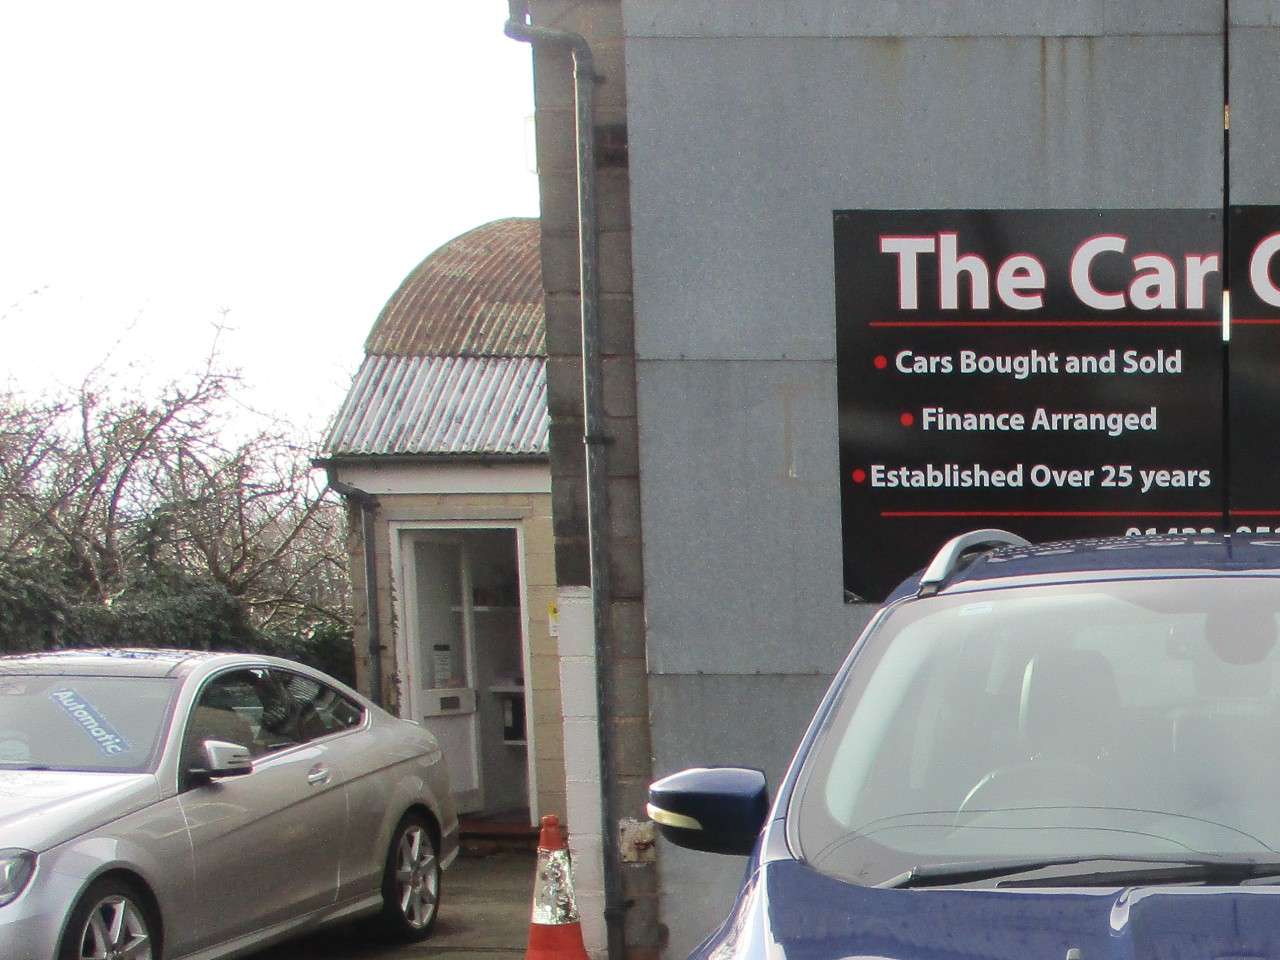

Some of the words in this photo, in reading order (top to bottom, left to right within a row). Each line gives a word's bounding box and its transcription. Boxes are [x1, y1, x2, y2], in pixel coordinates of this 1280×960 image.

[881, 233, 1046, 311] The
[1070, 236, 1219, 311] Car
[895, 350, 953, 374] Cars
[960, 349, 1059, 380] Bought
[1065, 349, 1116, 374] and
[1123, 349, 1182, 374] Sold
[922, 407, 1025, 431] Finance
[1031, 406, 1157, 437] Arranged
[871, 463, 1023, 488] Established
[1030, 464, 1095, 487] Over
[1101, 465, 1133, 487] 25
[1139, 469, 1211, 494] years
[54, 689, 124, 756] Automatic
